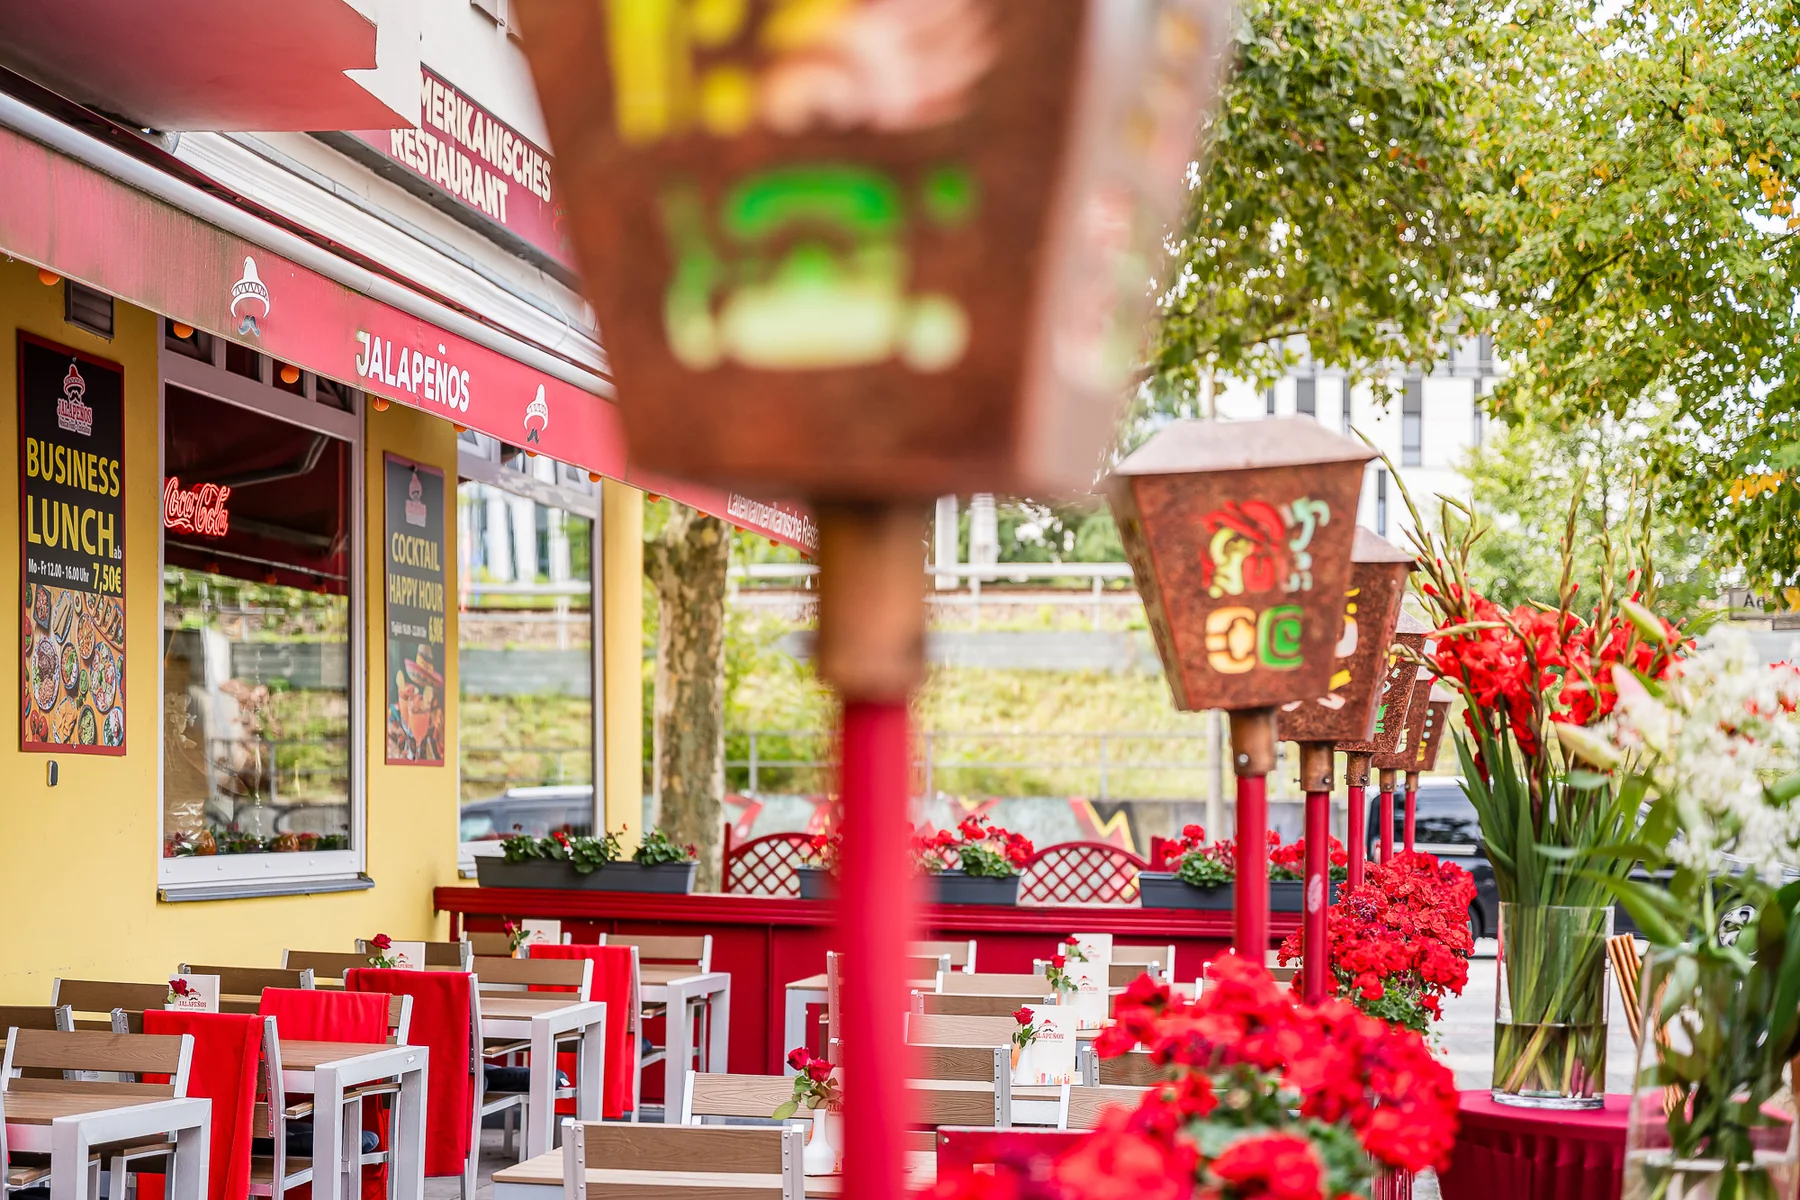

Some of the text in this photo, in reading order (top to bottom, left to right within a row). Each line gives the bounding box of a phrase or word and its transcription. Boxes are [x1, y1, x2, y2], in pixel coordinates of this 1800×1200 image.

[420, 72, 552, 203] MERIKANISCHES
[390, 128, 508, 224] RESTAURANT
[355, 329, 470, 413] JALAPEÑOS
[26, 437, 120, 498] BUSINESS
[27, 494, 114, 559] LUNCH
[727, 491, 802, 543] Lateinamerikanische
[28, 558, 37, 574] Mo
[40, 560, 47, 576] Fr
[79, 567, 90, 583] Uhr
[113, 545, 122, 560] ab
[391, 532, 440, 572] COCKTAIL
[93, 562, 122, 595] 7,50€
[389, 573, 443, 612] HAPPY HOUR
[1034, 1032, 1064, 1040] ALAPEÑOS
